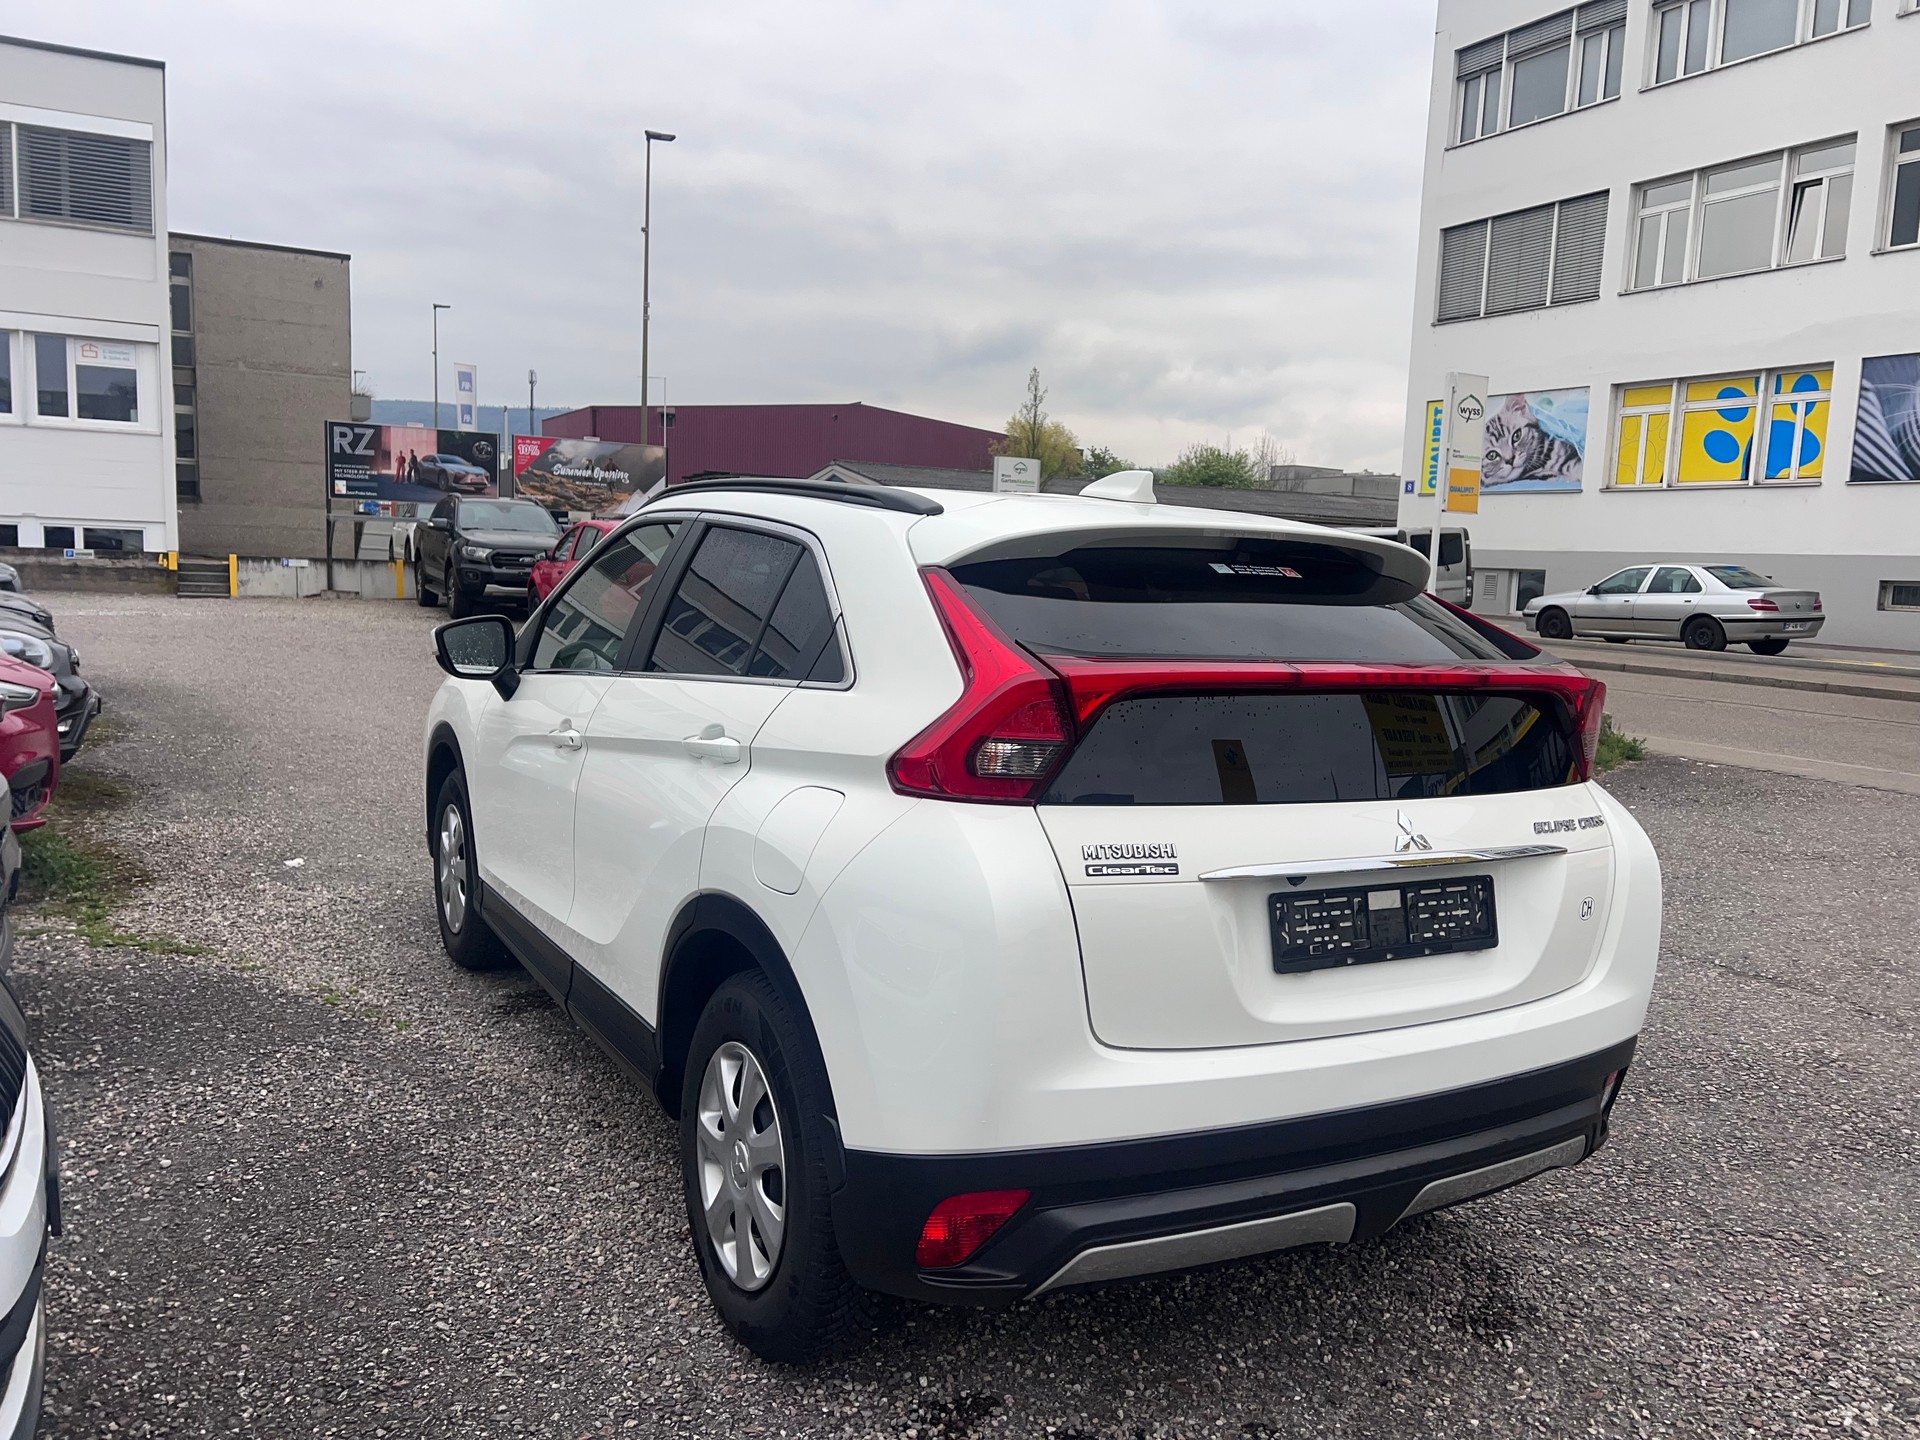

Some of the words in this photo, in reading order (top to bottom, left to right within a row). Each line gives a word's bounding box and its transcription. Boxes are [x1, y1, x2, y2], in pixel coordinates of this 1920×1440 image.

[1459, 406, 1481, 423] wyss
[333, 425, 376, 457] RZ
[517, 443, 540, 457] 10%
[552, 463, 592, 478] Summer
[593, 467, 630, 484] Opening
[1449, 485, 1475, 494] QUALIPET
[1533, 819, 1577, 834] ECLIPSE
[1577, 815, 1604, 830] CROSS
[1082, 843, 1177, 861] MITSUBISHI
[1087, 865, 1177, 875] ClearTec
[1581, 900, 1593, 918] CH
